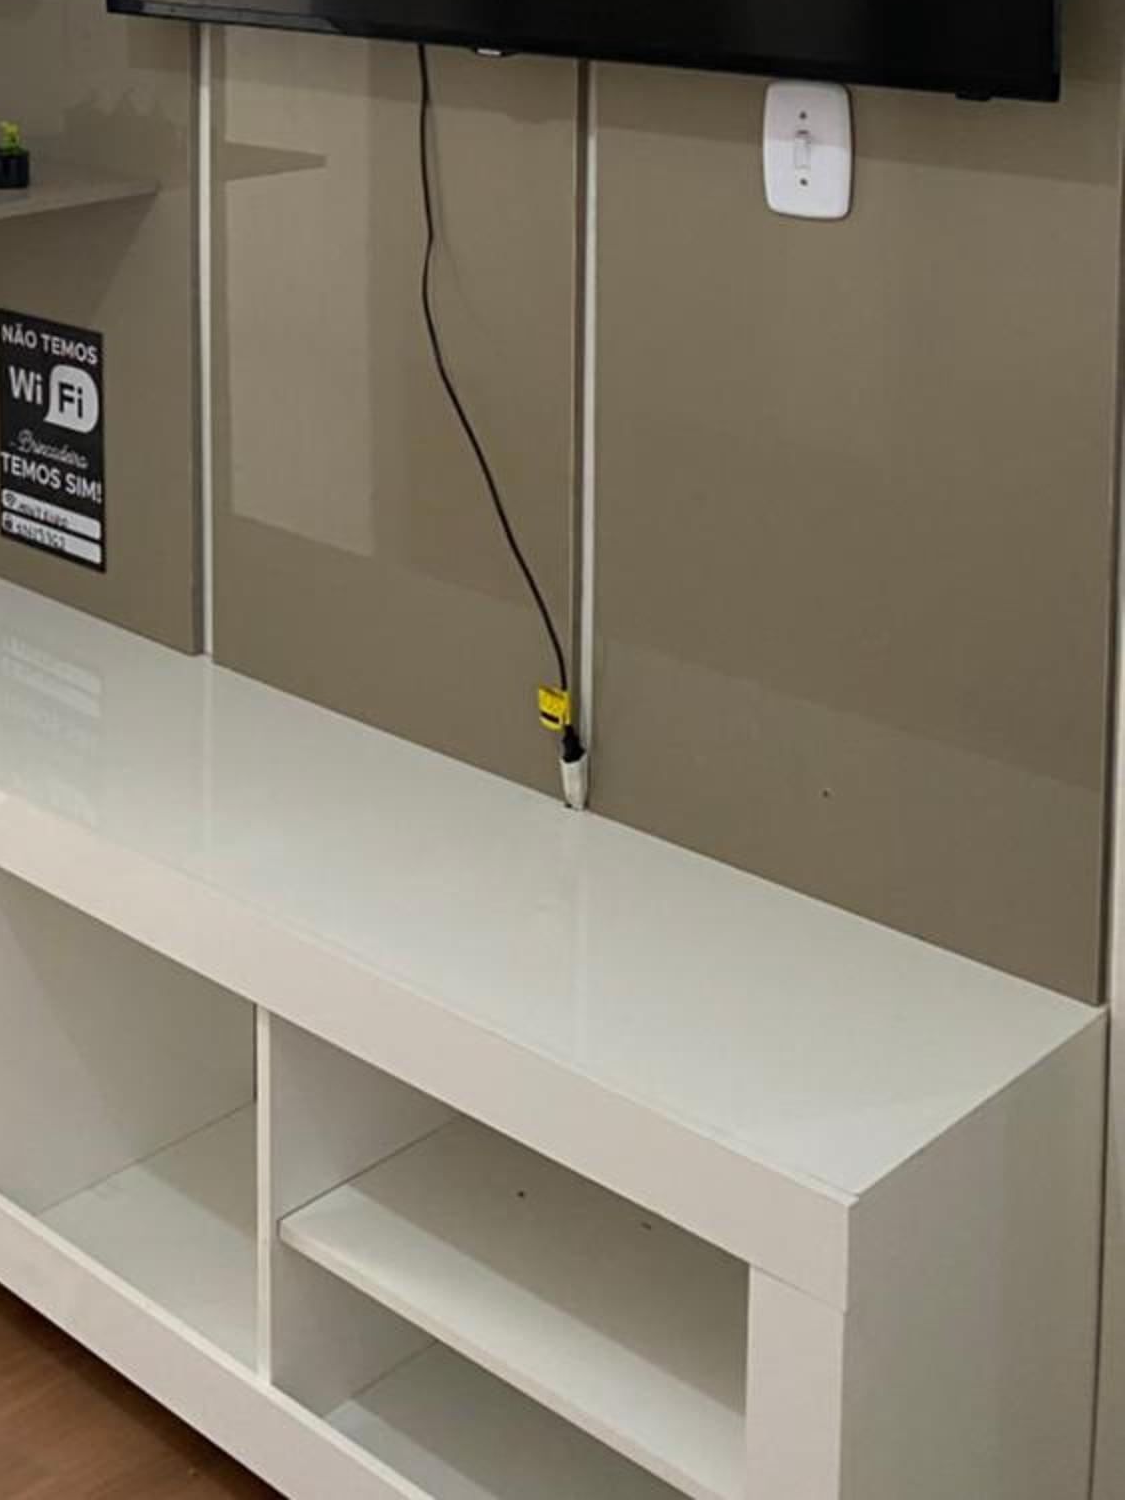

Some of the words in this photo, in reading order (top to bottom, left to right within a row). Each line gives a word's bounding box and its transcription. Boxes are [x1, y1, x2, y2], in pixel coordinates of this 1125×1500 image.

[1, 323, 37, 349] NÃO
[41, 333, 98, 365] TEMOS
[0, 451, 62, 489] TEMOS
[66, 475, 102, 504] SIM!
